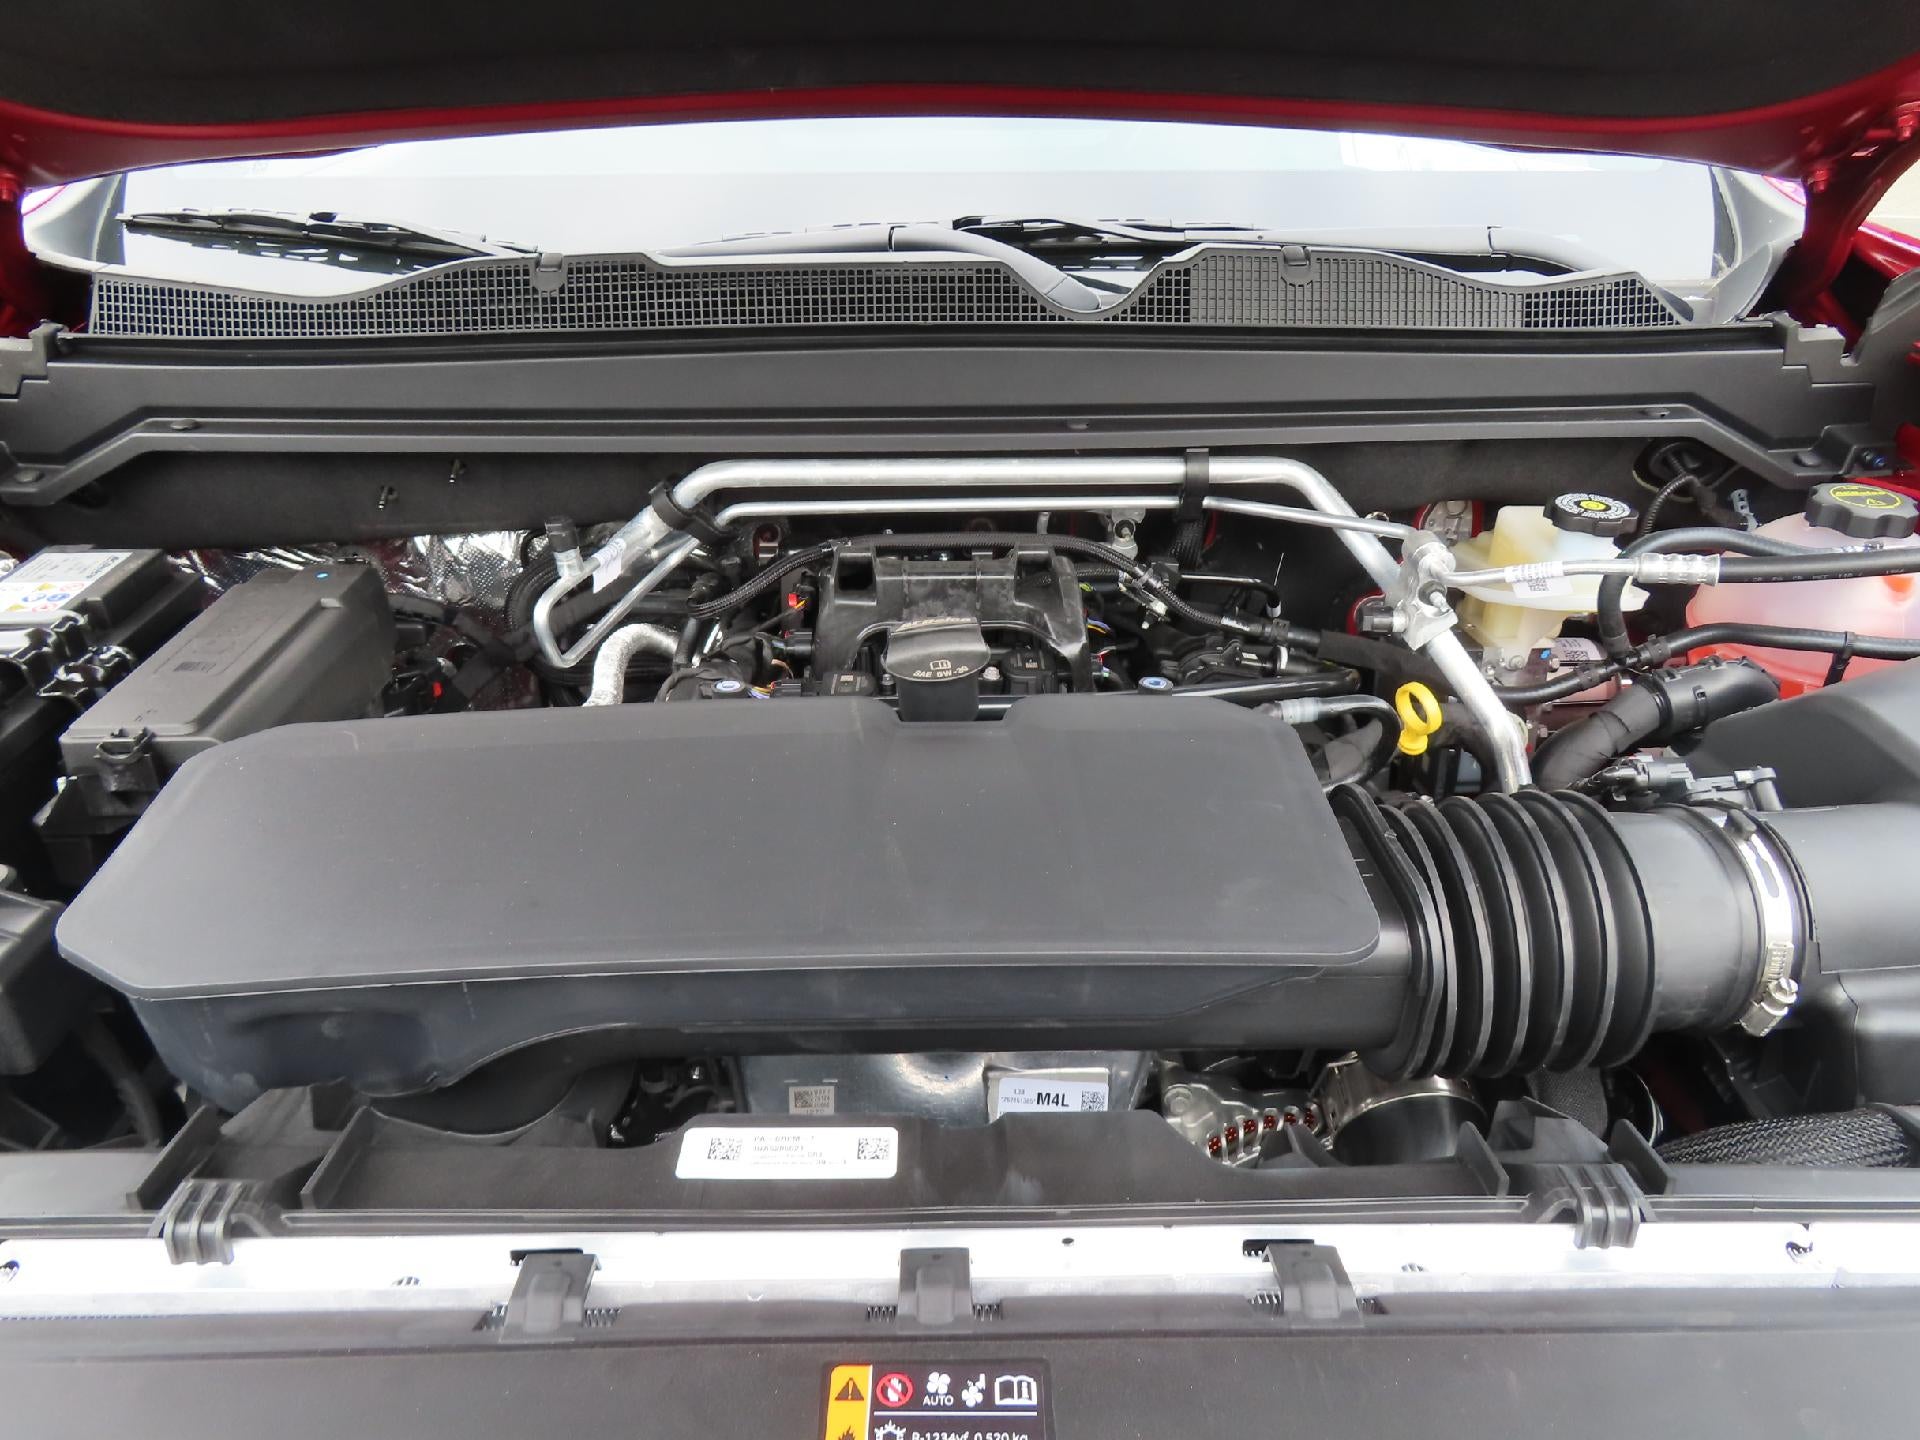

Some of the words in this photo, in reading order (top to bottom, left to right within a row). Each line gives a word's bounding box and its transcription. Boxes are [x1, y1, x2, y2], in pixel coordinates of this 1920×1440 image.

[912, 669, 932, 678] SAE
[1036, 1092, 1070, 1107] M4L
[923, 1395, 954, 1406] AUTO
